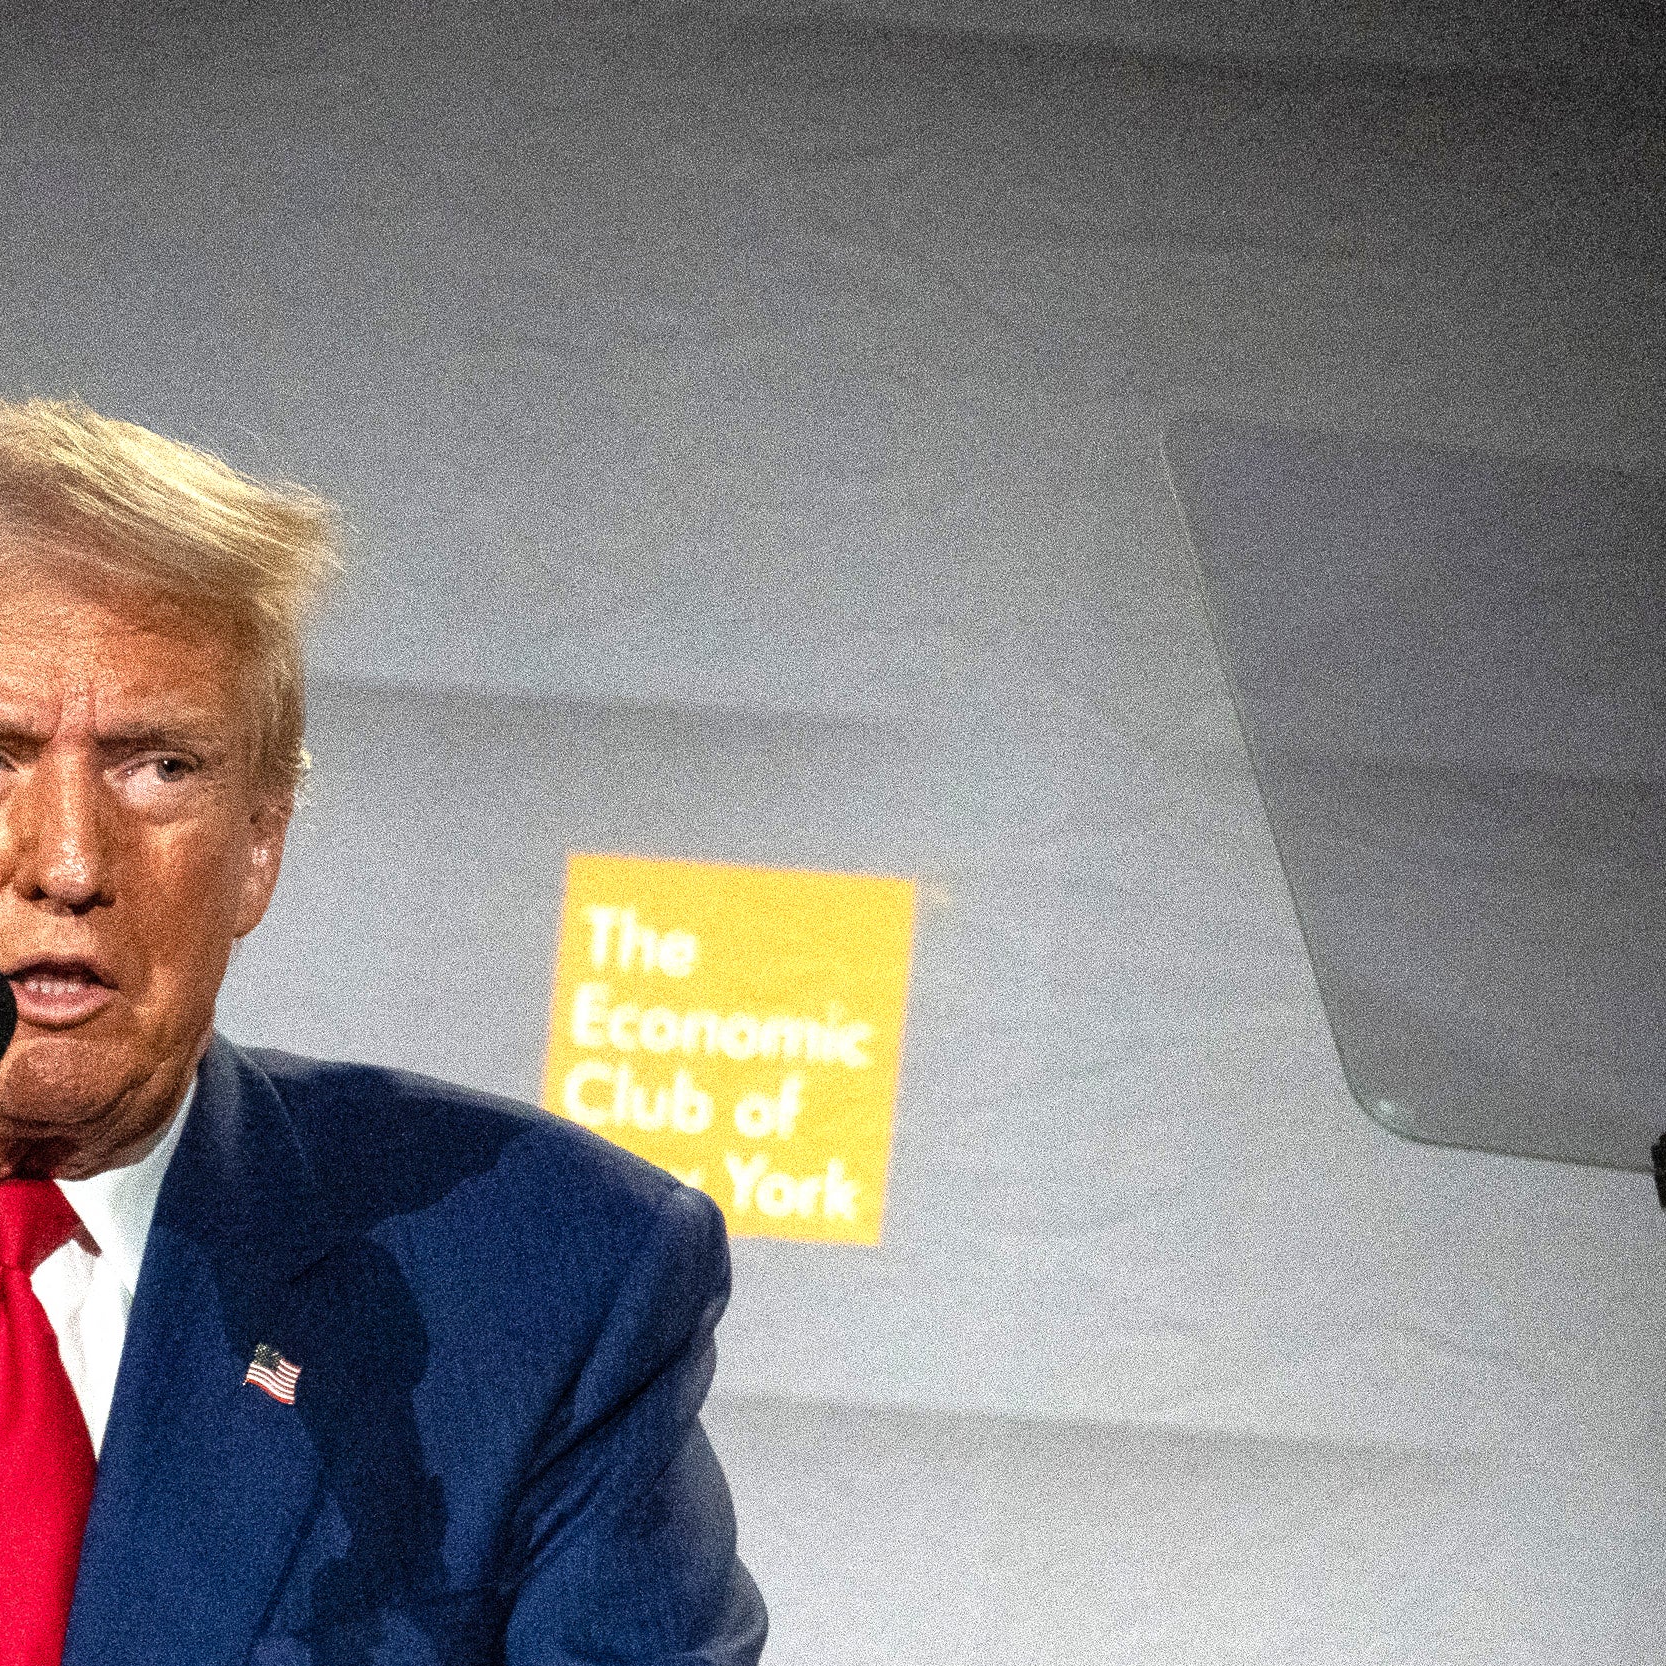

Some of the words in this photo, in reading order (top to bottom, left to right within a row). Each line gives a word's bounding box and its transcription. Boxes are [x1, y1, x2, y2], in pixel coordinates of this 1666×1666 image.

[584, 904, 697, 977] The
[571, 983, 874, 1069] Economic
[562, 1061, 714, 1134] Club
[734, 1074, 804, 1139] of
[726, 1152, 861, 1221] York
